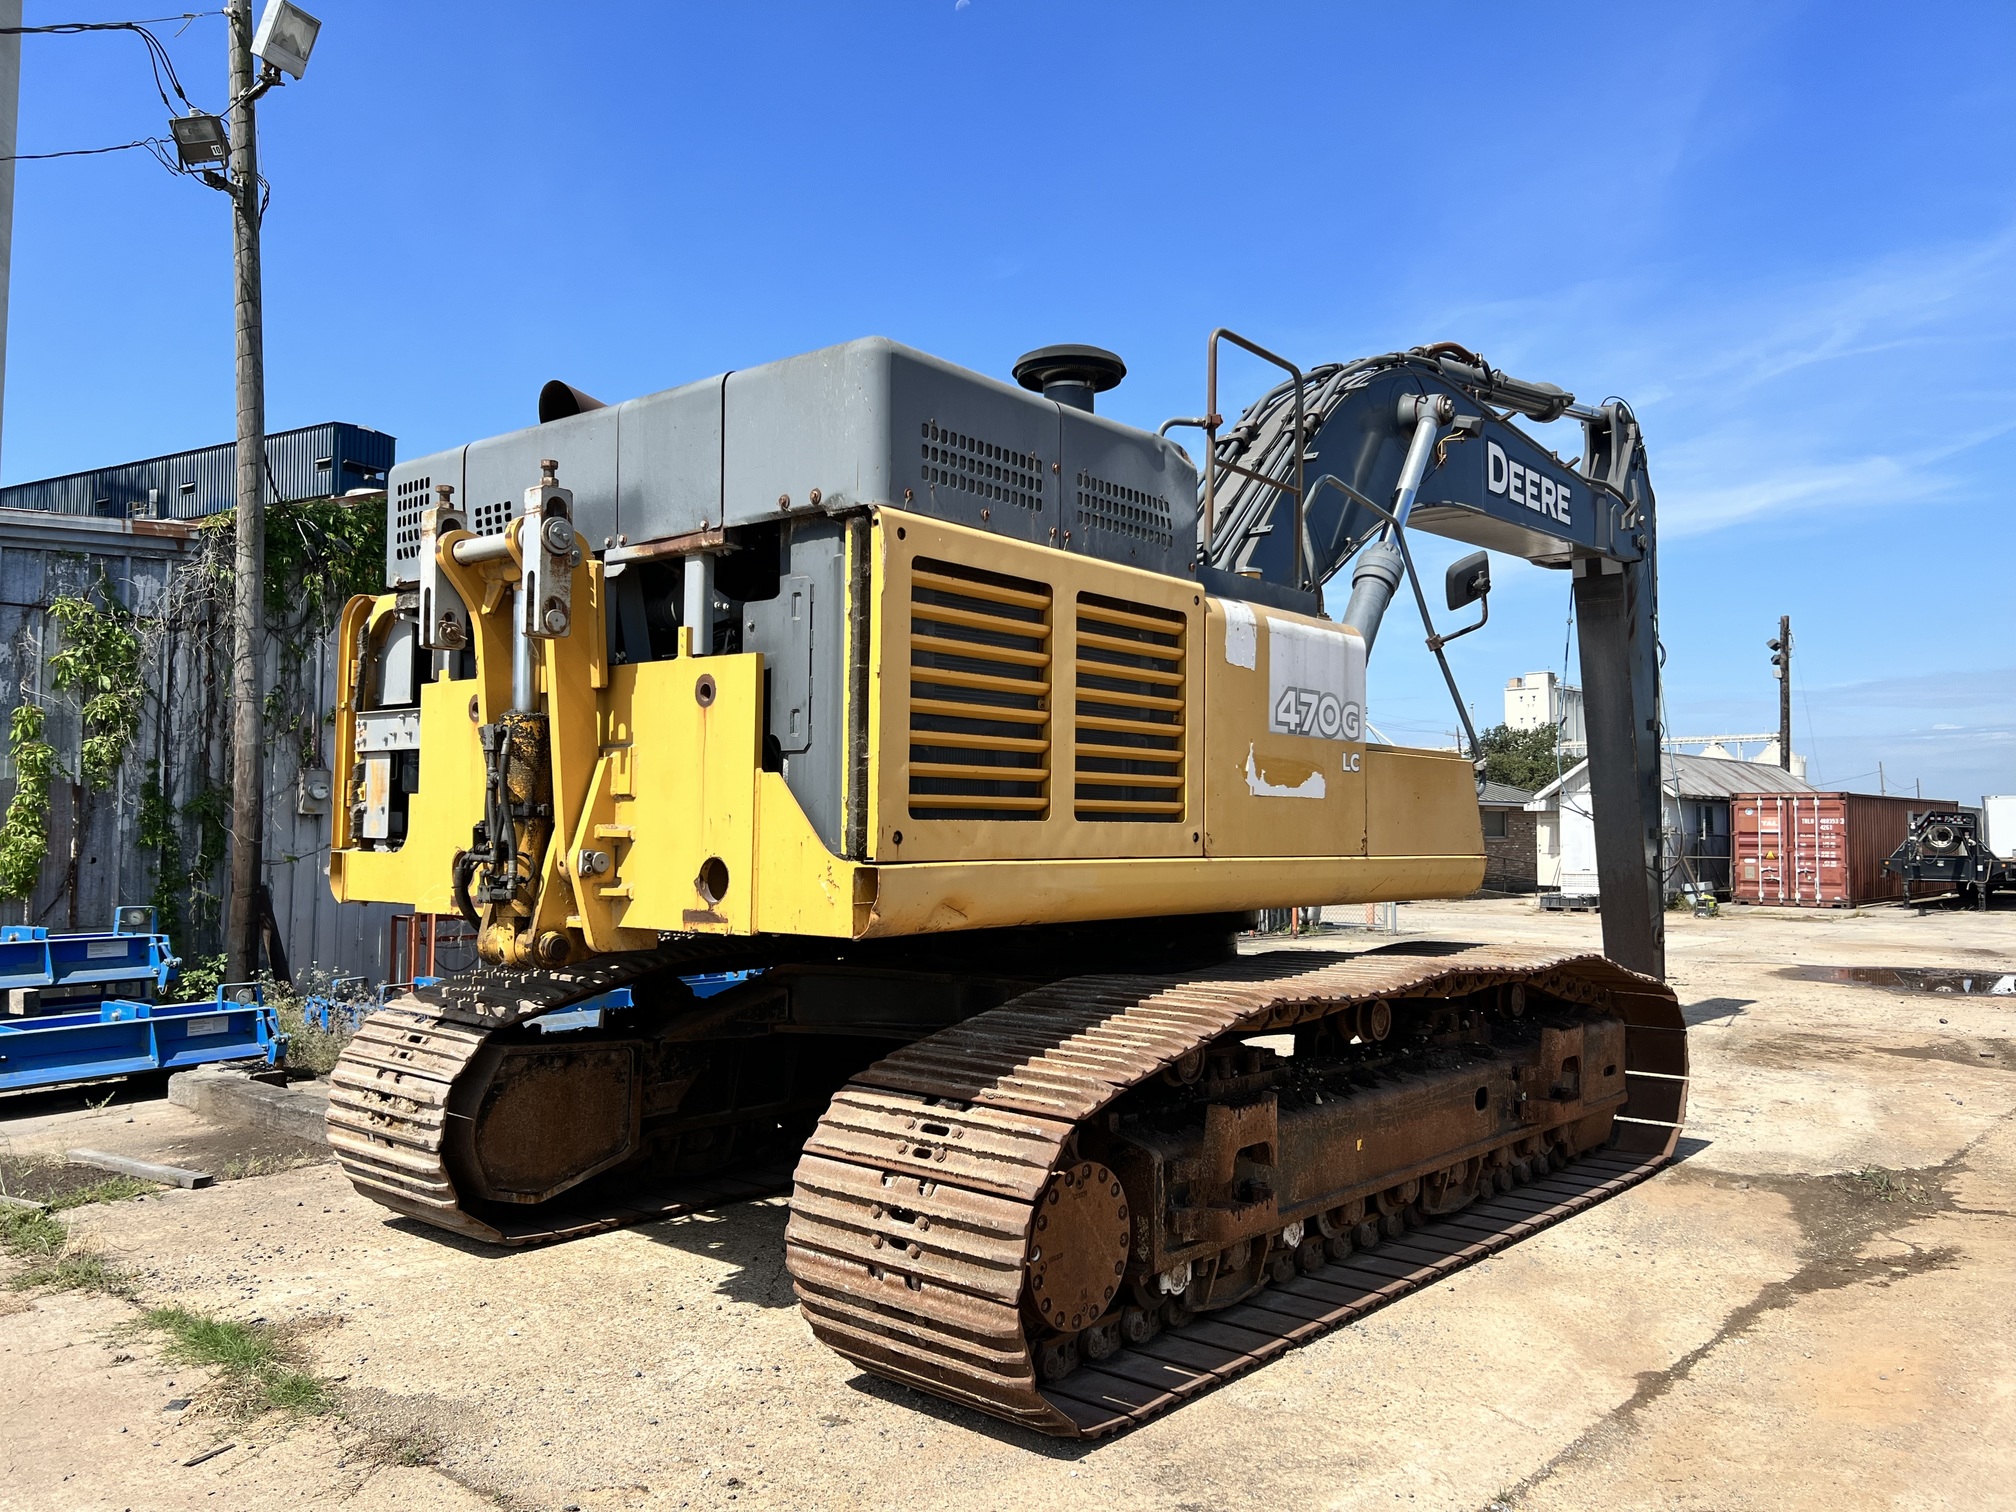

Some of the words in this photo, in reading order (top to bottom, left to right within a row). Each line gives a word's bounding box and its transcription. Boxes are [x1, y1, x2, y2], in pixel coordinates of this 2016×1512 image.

[212, 146, 222, 154] 10
[1487, 440, 1571, 525] DEERE
[1275, 686, 1360, 741] 470G
[1342, 752, 1360, 772] LC
